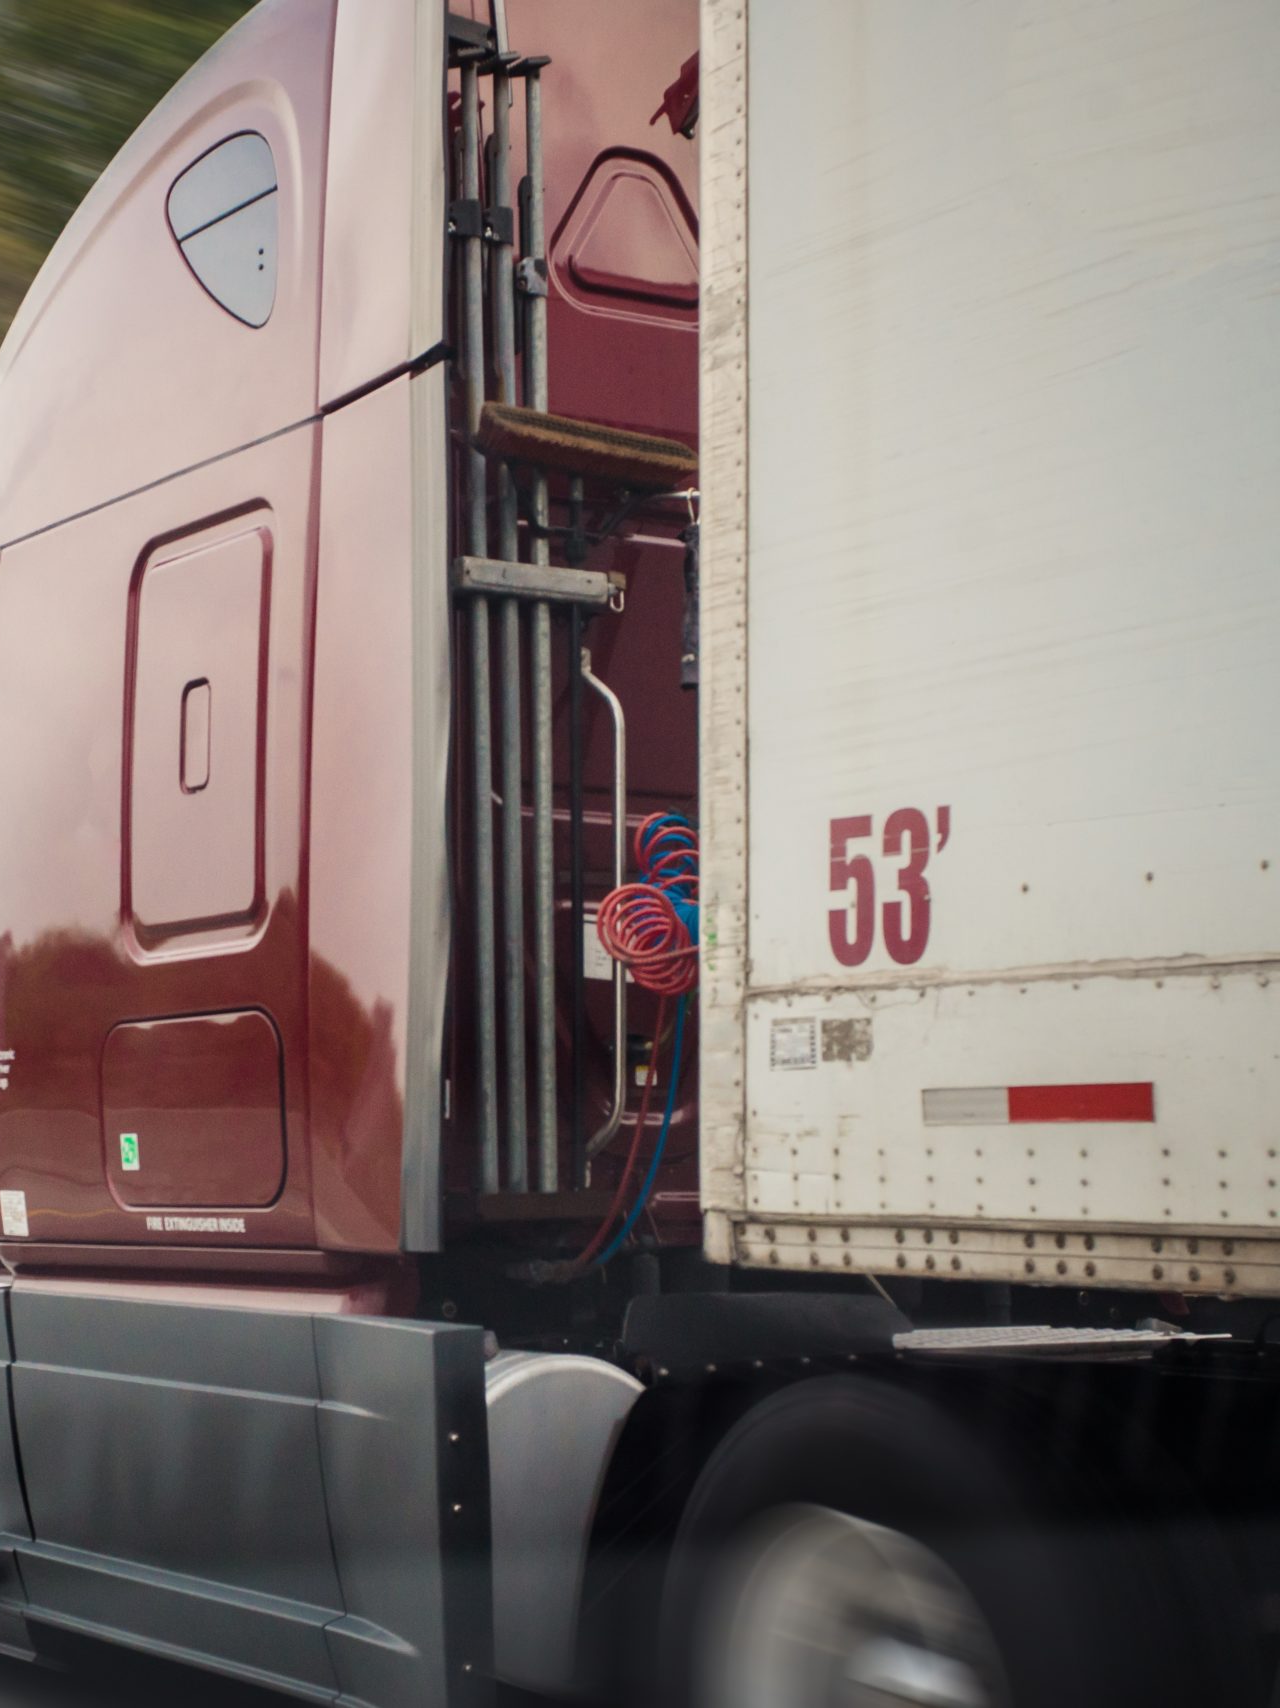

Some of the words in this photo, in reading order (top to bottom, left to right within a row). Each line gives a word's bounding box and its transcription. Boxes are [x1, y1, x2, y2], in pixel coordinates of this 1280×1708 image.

[146, 1216, 163, 1231] FIRE
[164, 1216, 218, 1232] EXTINGUISHER
[219, 1217, 246, 1233] INSIDE
